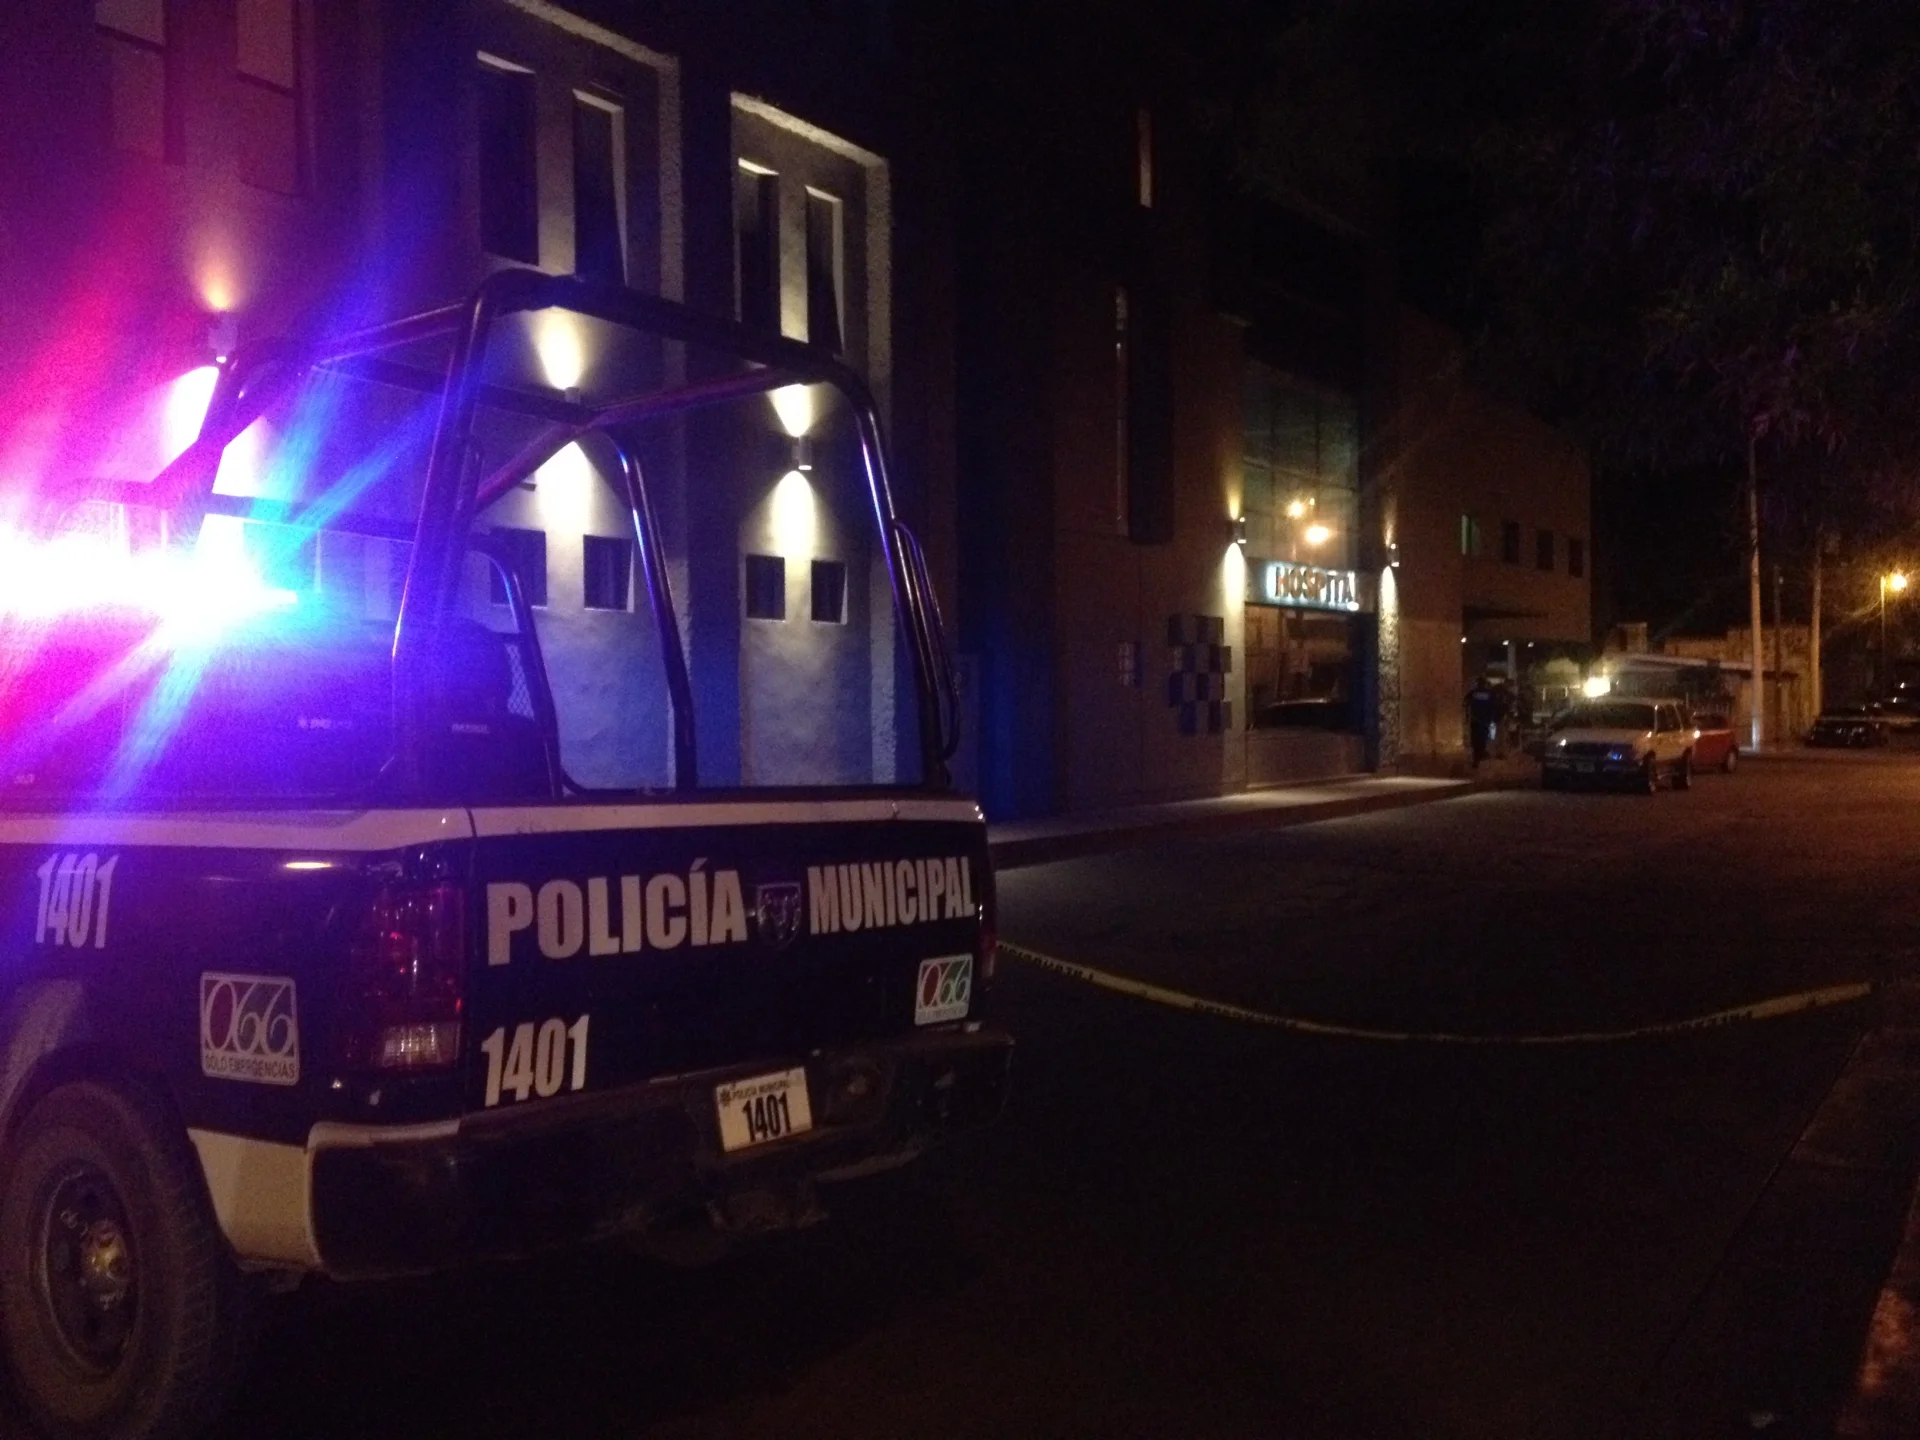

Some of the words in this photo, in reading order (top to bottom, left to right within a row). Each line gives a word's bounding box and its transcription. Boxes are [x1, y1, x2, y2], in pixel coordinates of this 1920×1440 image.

[1274, 566, 1361, 607] HOSPITA
[36, 853, 118, 949] 1401
[486, 858, 748, 966] POLICÍA
[807, 856, 975, 936] MUNICIPAL
[206, 980, 296, 1056] 066
[920, 959, 970, 1008] 066
[481, 1014, 590, 1107] 1401
[742, 1091, 792, 1143] 1401
